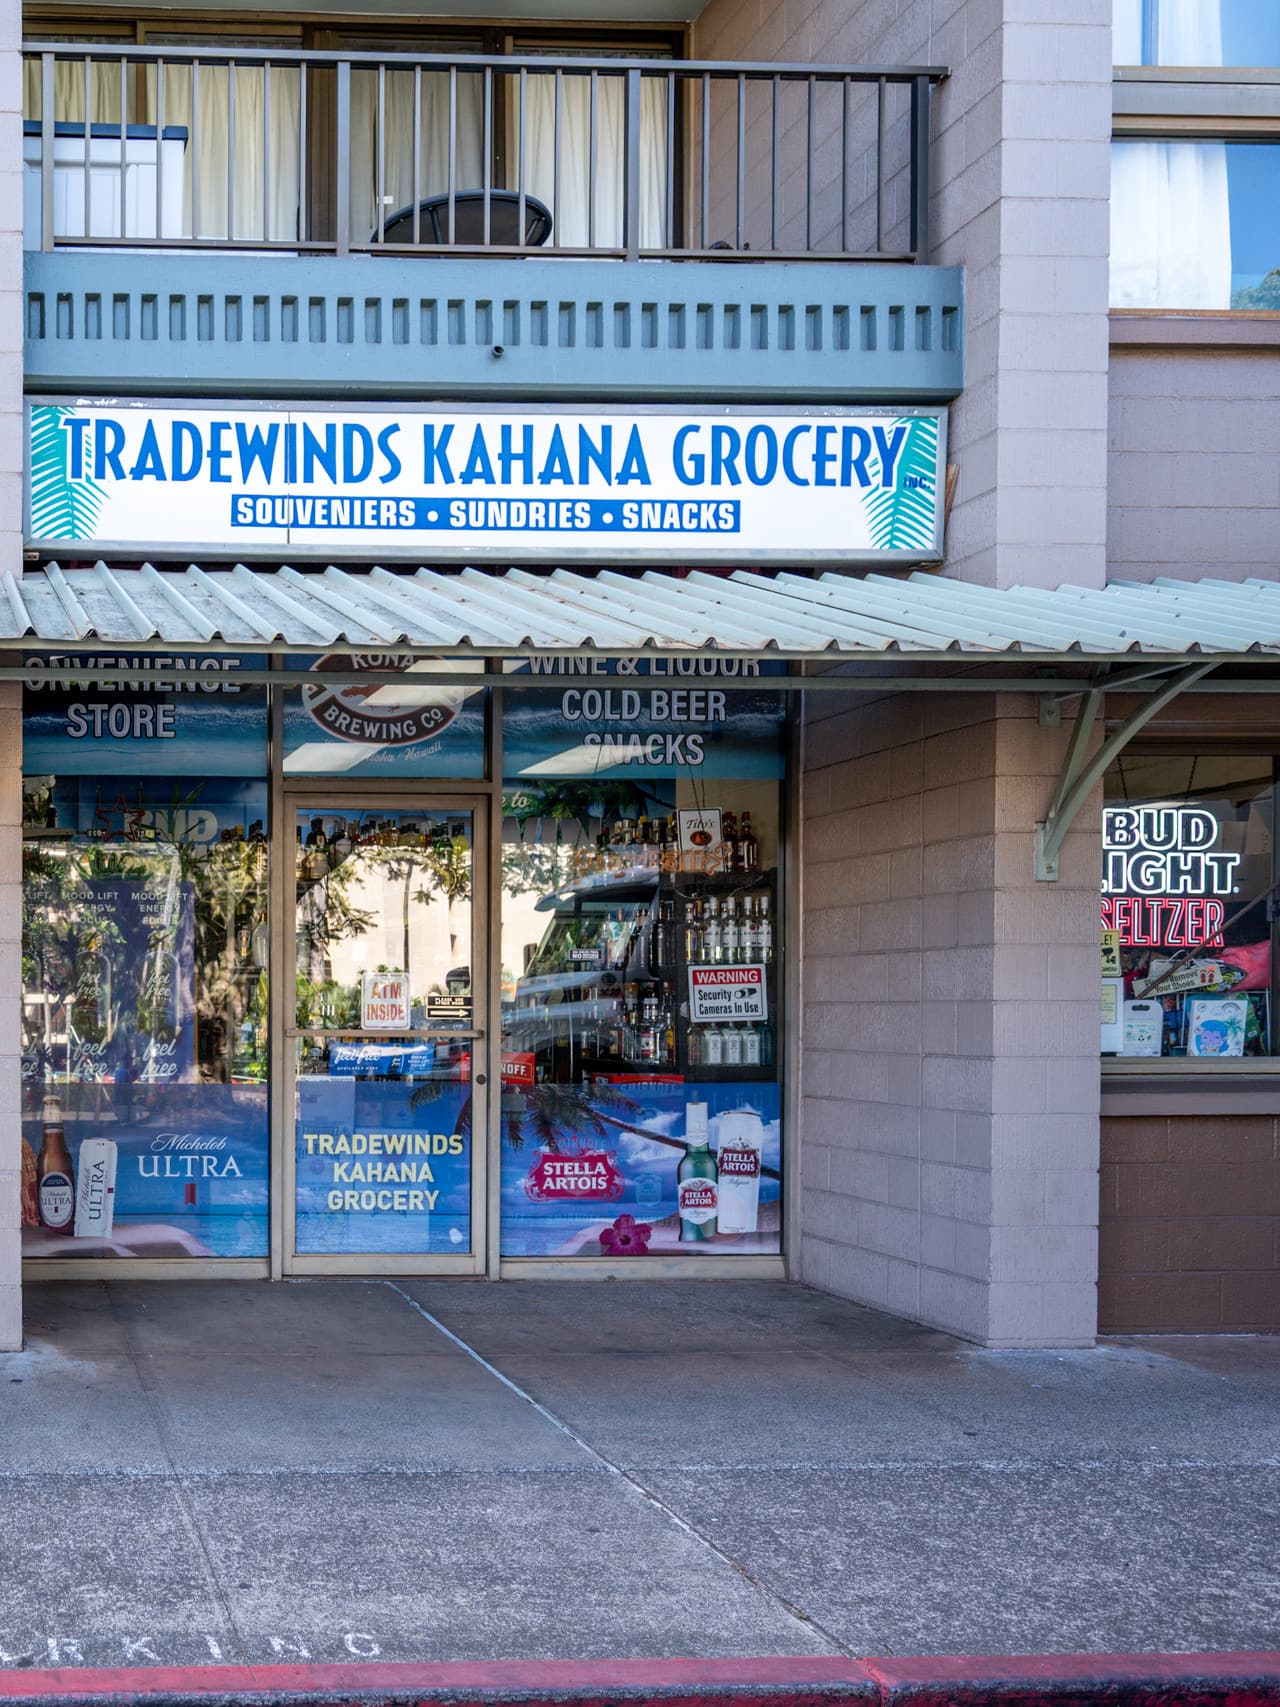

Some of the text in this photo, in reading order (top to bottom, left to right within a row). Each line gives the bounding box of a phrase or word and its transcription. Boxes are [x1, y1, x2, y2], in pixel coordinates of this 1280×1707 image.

[63, 418, 402, 486] TRADEWINDS
[424, 423, 651, 487] KAHANA
[673, 424, 908, 489] GROCERY
[237, 497, 735, 530] SOUVENIERS SUNDRIES SNACKS
[24, 657, 240, 693] ONVENIENCE
[529, 657, 608, 675] WINE
[562, 689, 727, 722] COLD BEER
[66, 704, 176, 738] STORE
[323, 705, 417, 740] BREWING
[583, 733, 705, 766] SNACKS
[686, 818, 714, 831] Tito's
[1102, 808, 1218, 850] BUD
[1101, 851, 1241, 894] IGHT.
[1101, 897, 1224, 947] SELTZER
[696, 970, 759, 983] WARNING
[371, 981, 402, 999] ATM
[698, 989, 732, 1002] Security
[367, 1003, 405, 1021] INSIDE
[699, 1003, 759, 1015] Cameras In Use
[150, 1133, 229, 1152] Michelob
[303, 1134, 464, 1155] TRADEWINDS
[138, 1155, 243, 1177] ULTRA
[722, 1163, 755, 1171] ARTOIS
[723, 1153, 755, 1162] STELLA
[333, 1162, 434, 1183] KAHANA
[544, 1162, 607, 1175] STELLA
[89, 1160, 104, 1220] ULTRA
[543, 1177, 608, 1190] ARTOIS
[327, 1189, 441, 1211] GROCERY
